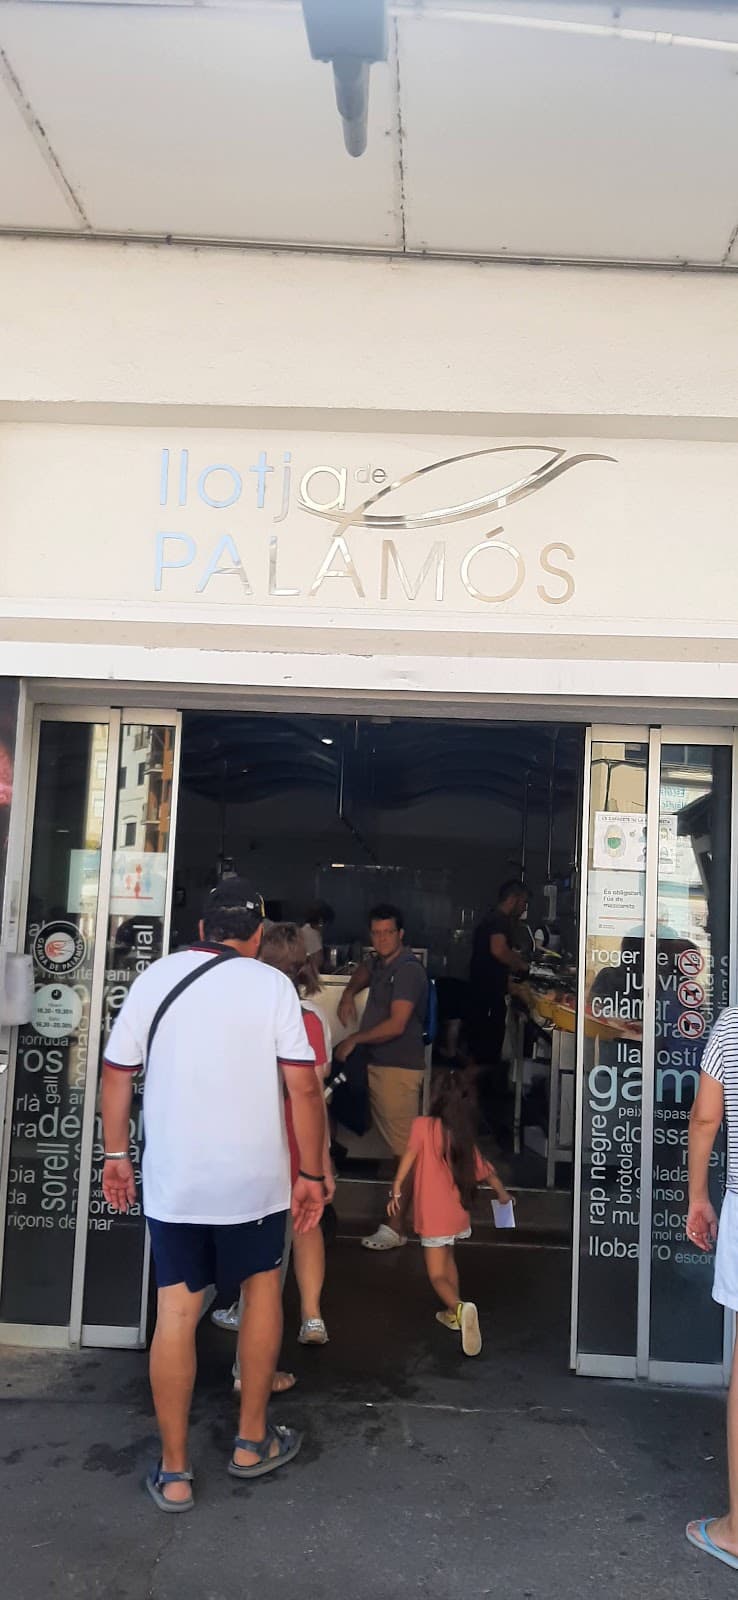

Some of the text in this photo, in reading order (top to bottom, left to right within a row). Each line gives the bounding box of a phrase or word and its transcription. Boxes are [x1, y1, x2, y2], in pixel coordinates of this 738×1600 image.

[159, 447, 388, 523] llotja de
[153, 526, 576, 604] PALAMÓS
[133, 925, 153, 973] erial
[591, 949, 641, 968] roger
[617, 1043, 697, 1066] llaostí
[43, 1076, 60, 1104] gall
[588, 1064, 701, 1112] gam
[655, 1108, 691, 1121] spasa
[612, 1121, 689, 1145] clossa
[36, 1143, 69, 1212] sorell
[590, 1114, 612, 1225] rap negre
[616, 1143, 633, 1204] bròtola
[612, 1209, 688, 1228] muclos
[589, 1236, 671, 1260] llobaro
[652, 1231, 672, 1241] mol
